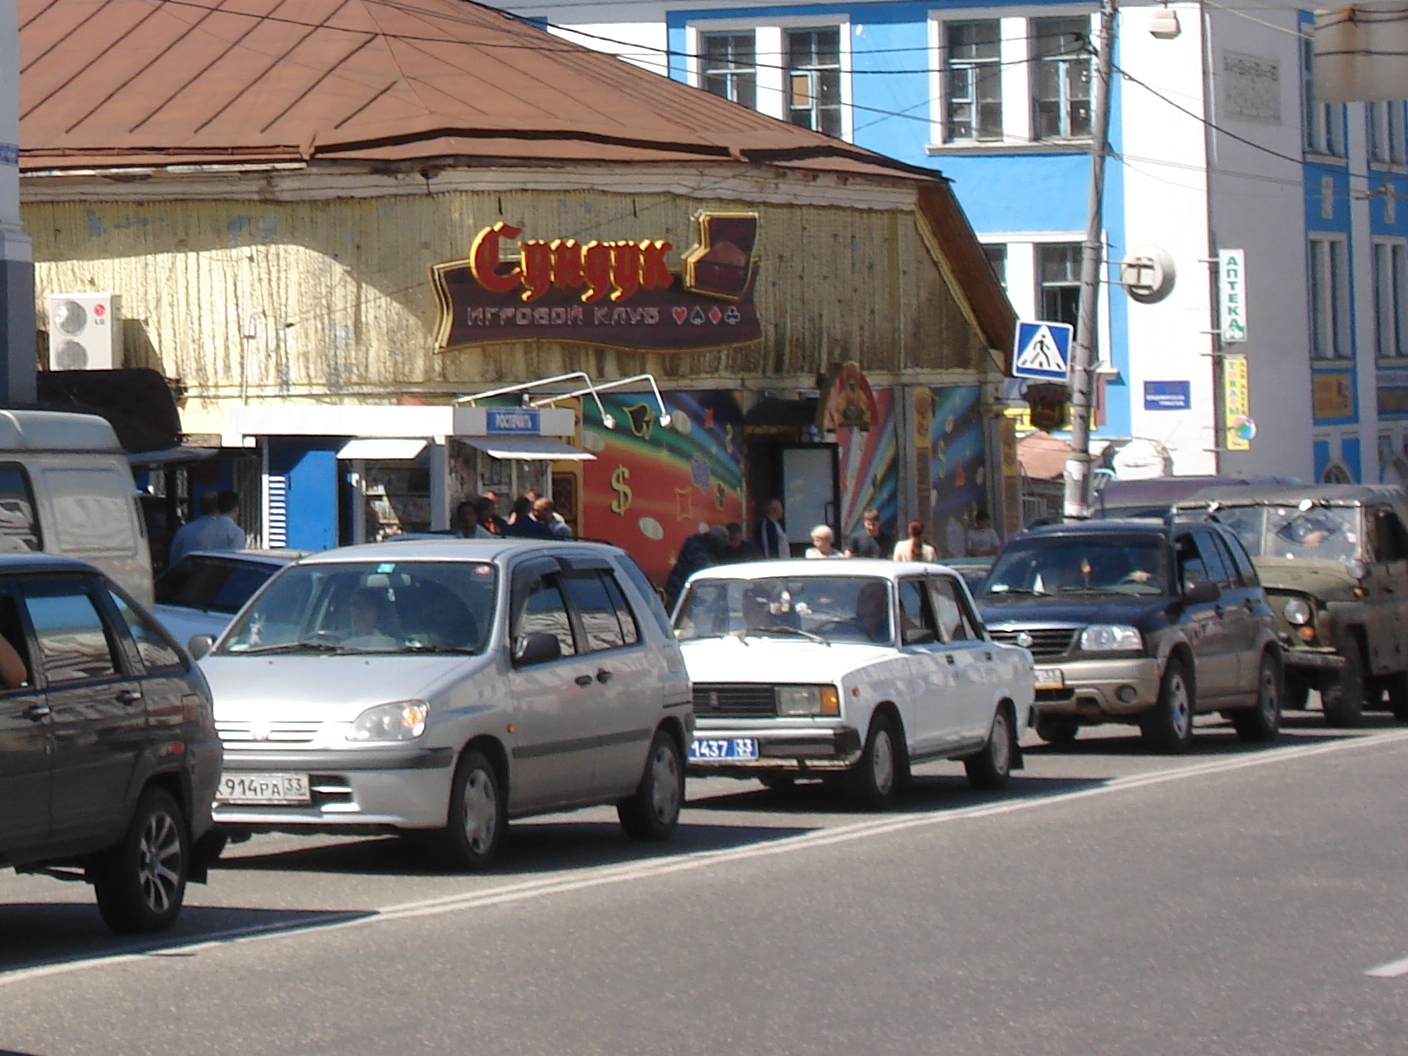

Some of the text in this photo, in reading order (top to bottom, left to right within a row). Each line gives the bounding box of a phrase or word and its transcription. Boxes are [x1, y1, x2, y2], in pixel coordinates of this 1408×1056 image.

[469, 220, 675, 302] Сундук
[1225, 255, 1243, 332] АПТЕКА
[467, 304, 660, 327] ИГРОВОЙ КЛУБ
